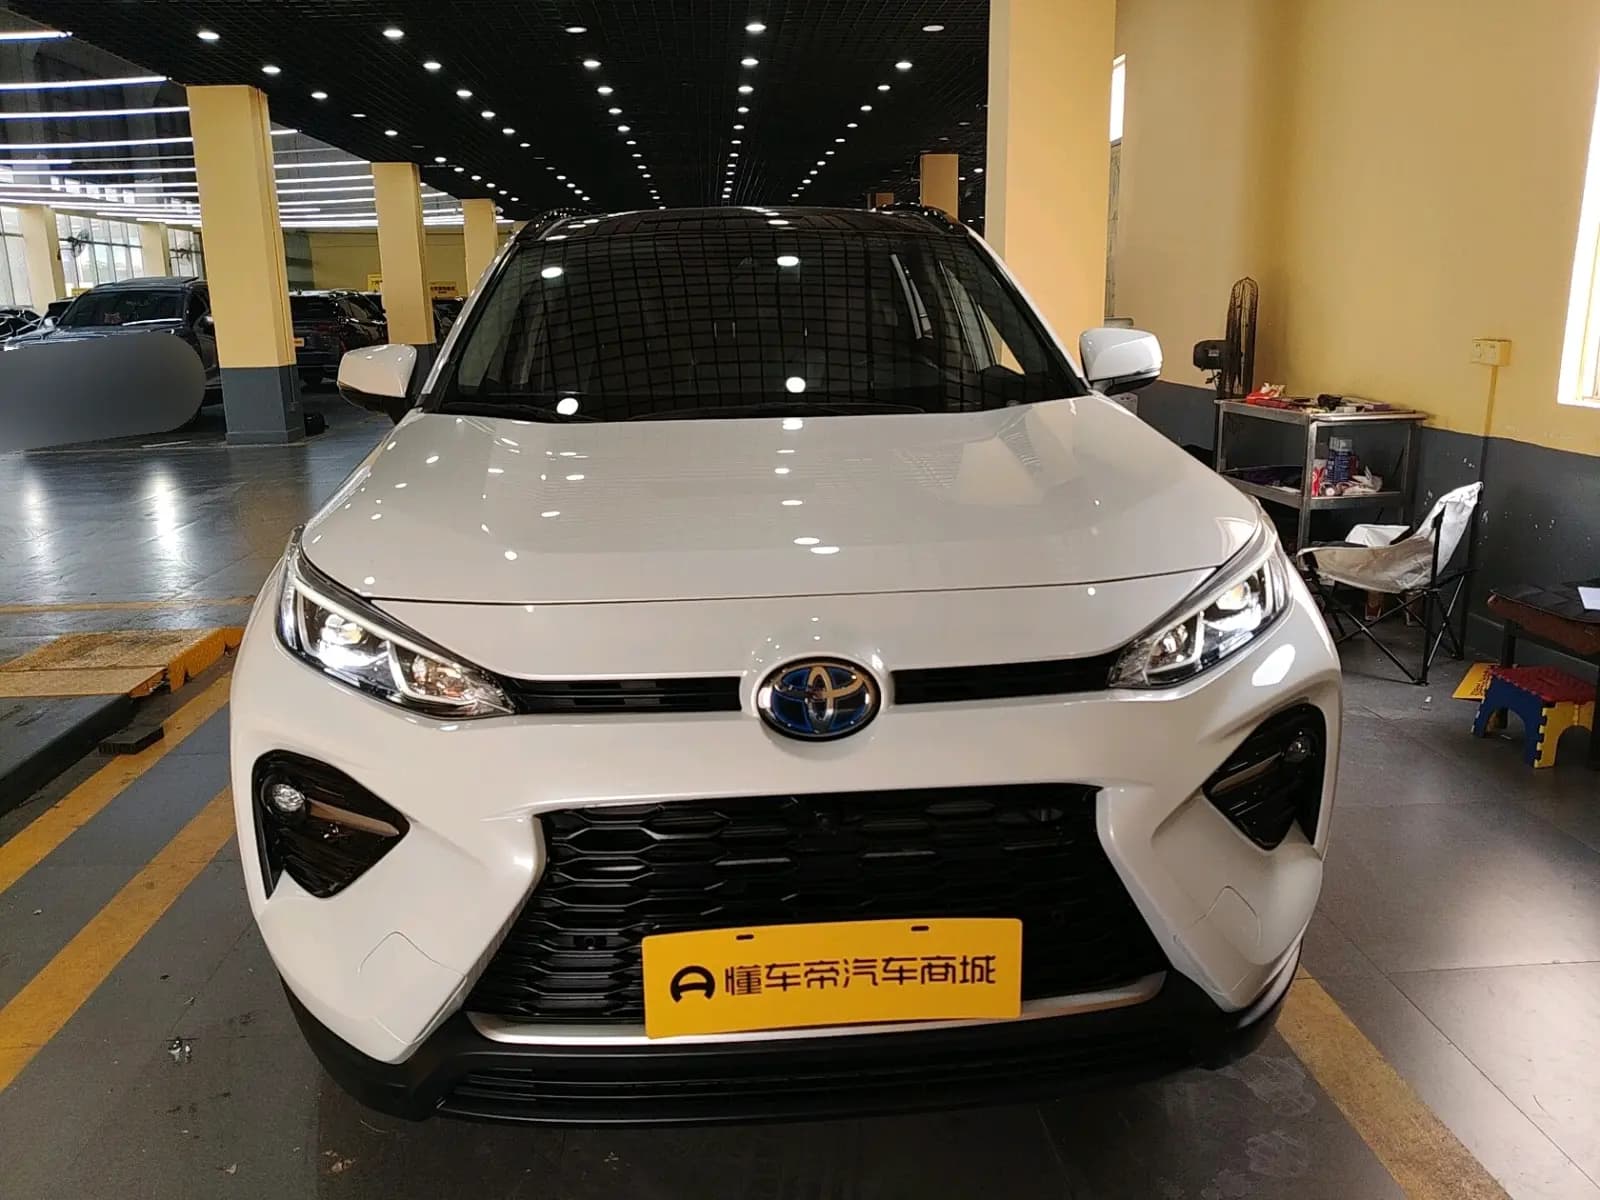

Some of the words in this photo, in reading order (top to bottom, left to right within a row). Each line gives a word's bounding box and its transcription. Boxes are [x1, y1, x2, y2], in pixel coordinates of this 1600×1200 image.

[725, 955, 996, 996] 懂车帝汽车商城
